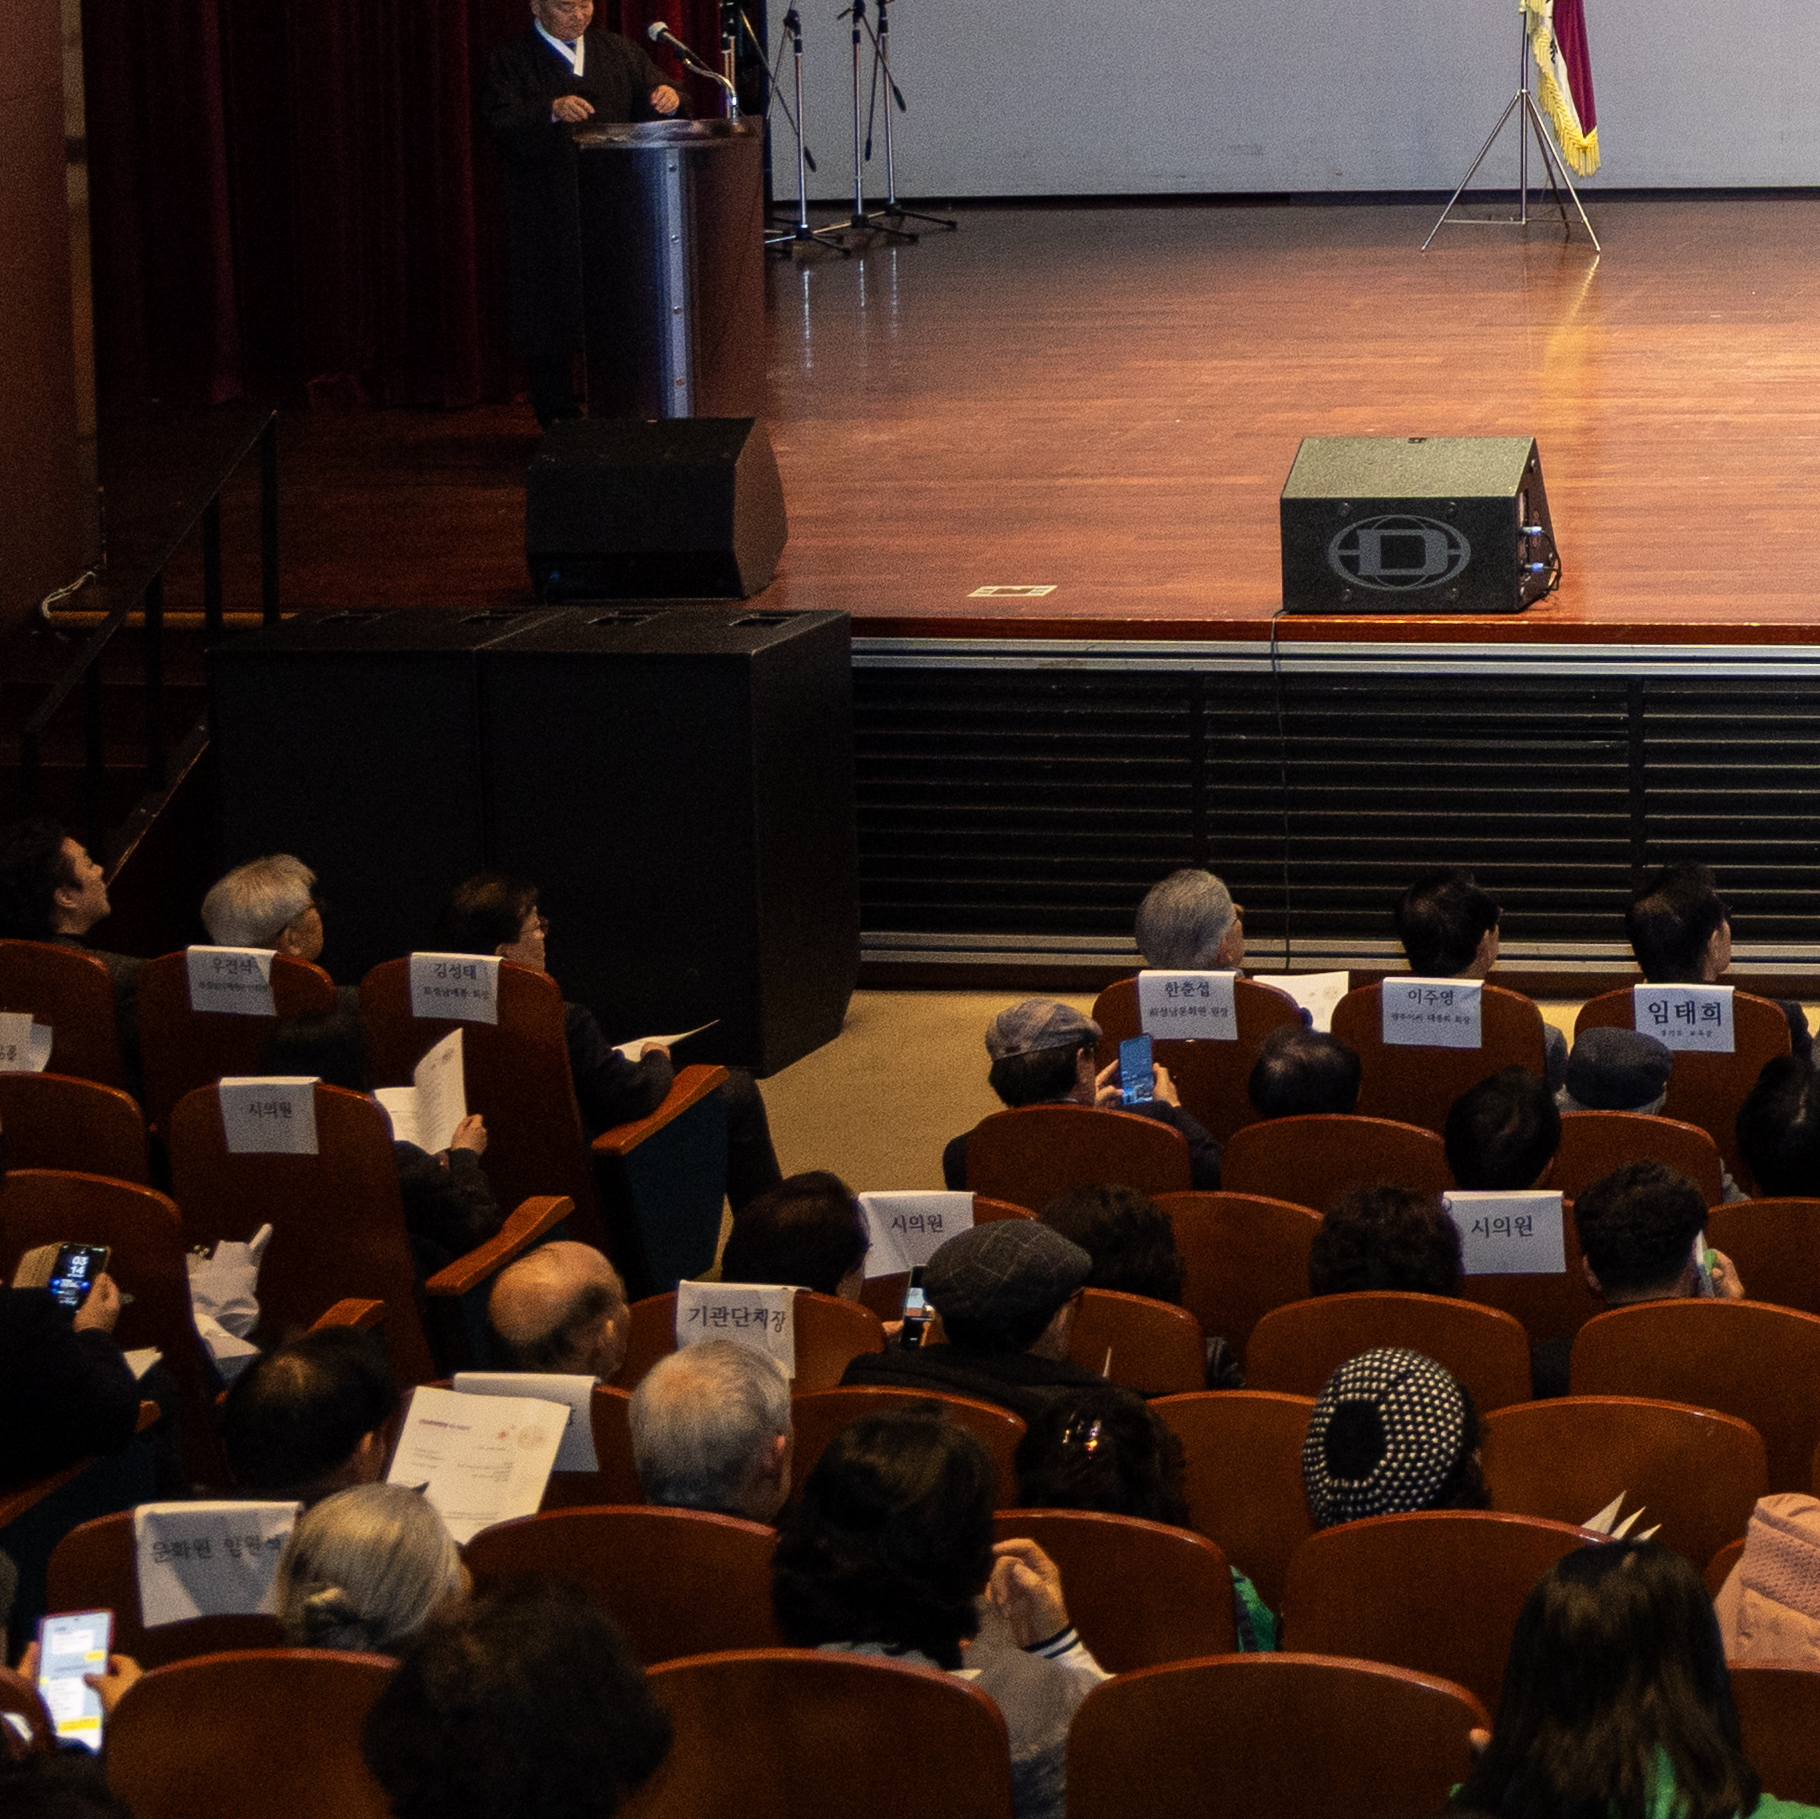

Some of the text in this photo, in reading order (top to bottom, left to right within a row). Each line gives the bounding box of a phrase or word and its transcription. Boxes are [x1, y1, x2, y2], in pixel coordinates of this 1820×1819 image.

[1408, 988, 1454, 1006] 이주영
[1648, 1000, 1722, 1026] 임태희
[891, 1214, 944, 1234] 시의원
[1471, 1215, 1534, 1238] 시의원
[687, 1305, 786, 1334] 기관단체장
